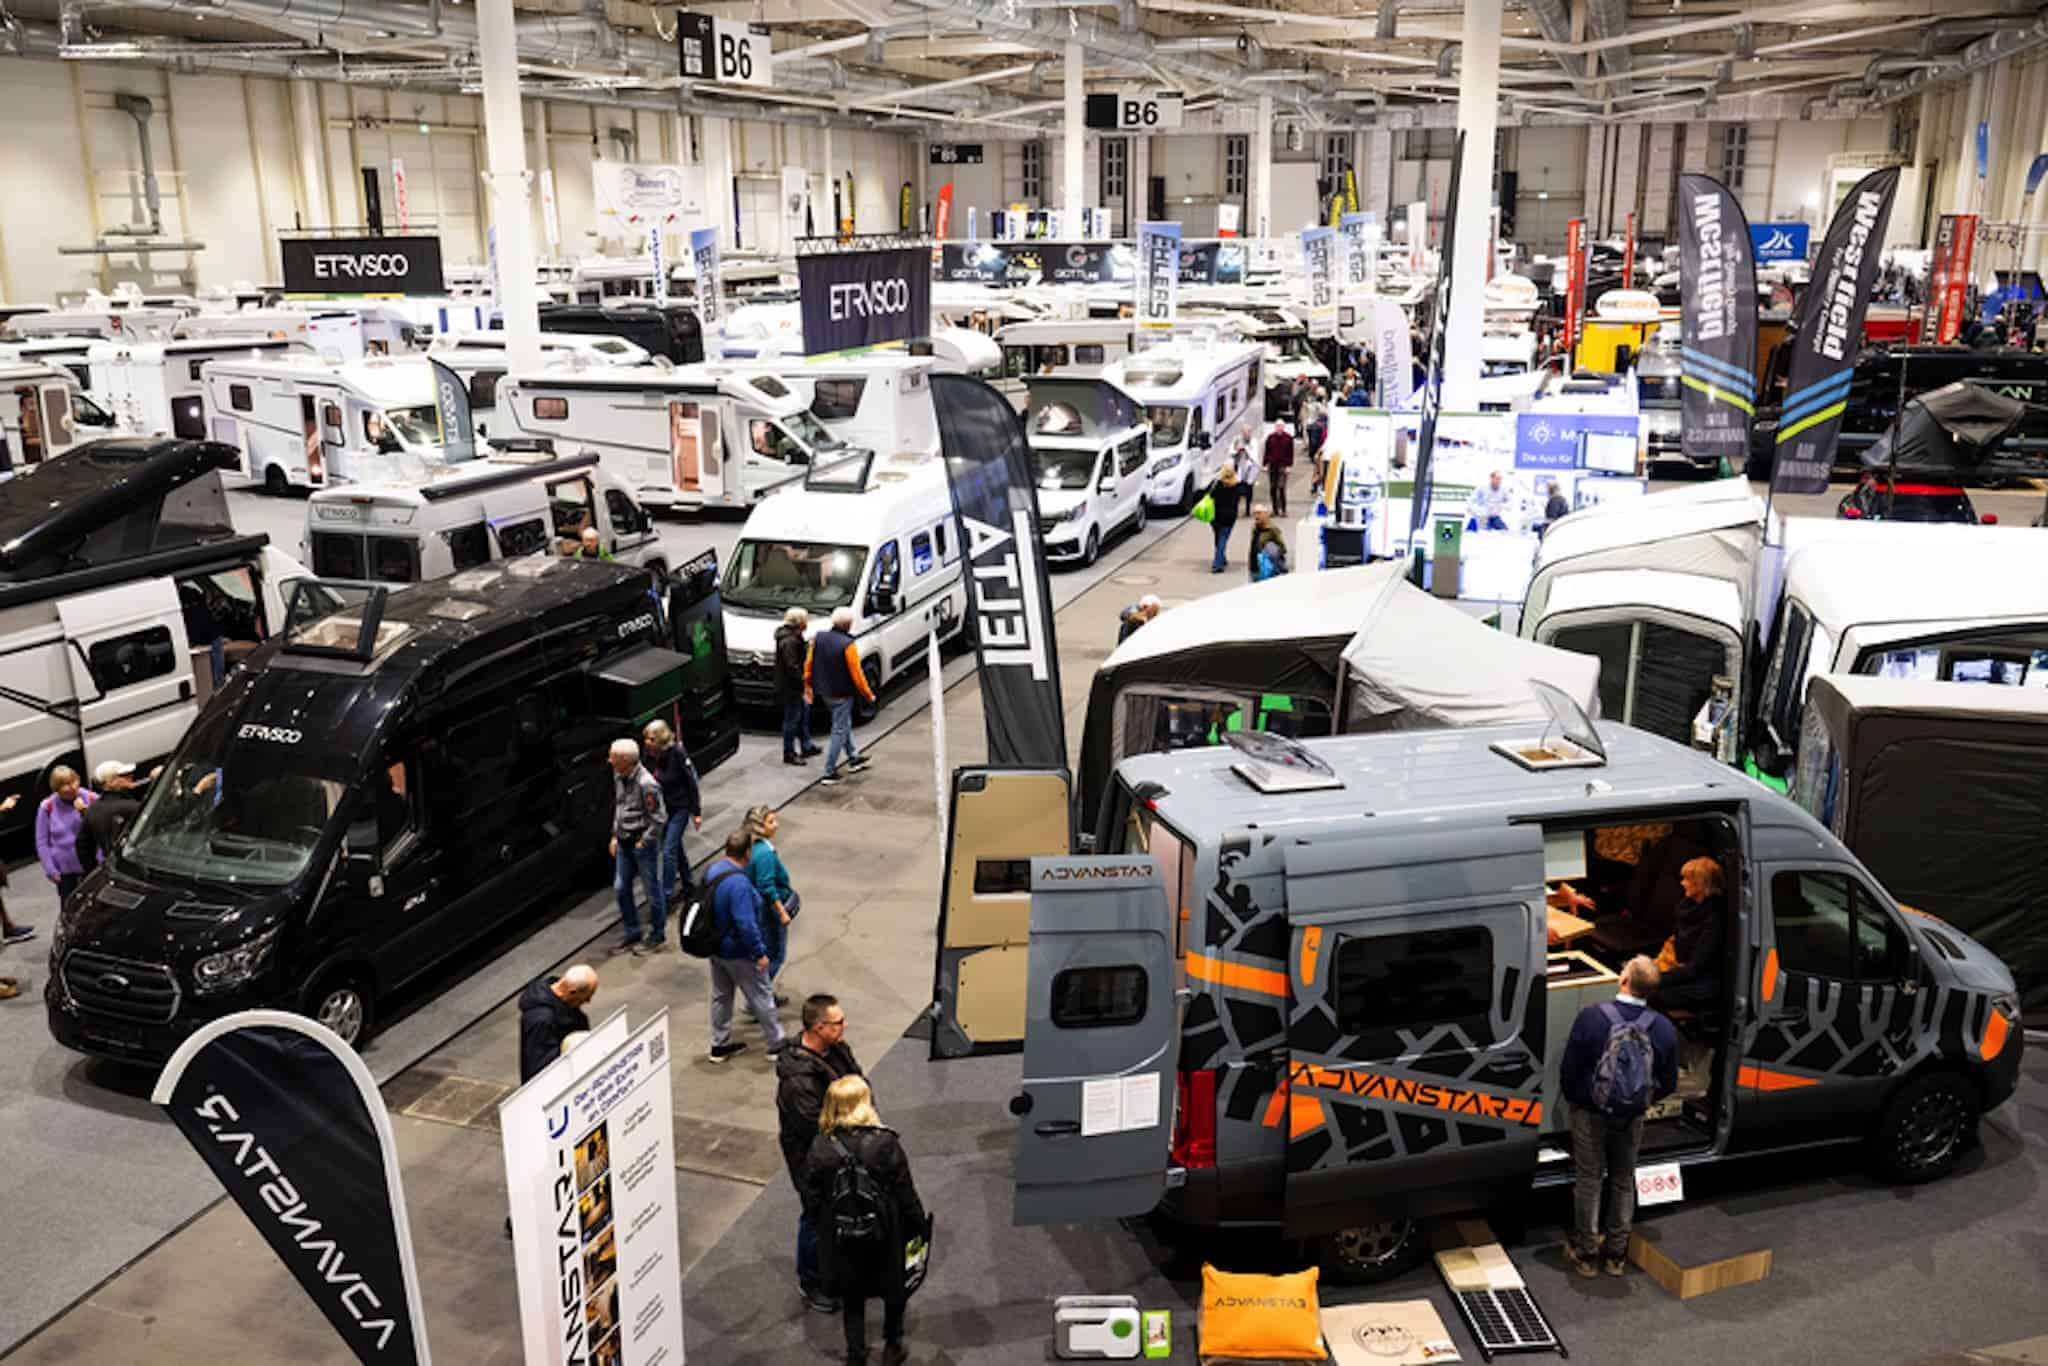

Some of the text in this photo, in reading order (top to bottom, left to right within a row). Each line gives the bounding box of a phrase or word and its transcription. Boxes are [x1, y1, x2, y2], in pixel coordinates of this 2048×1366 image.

[720, 33, 752, 79] B6
[1123, 101, 1158, 125] B6
[314, 254, 409, 278] ETRVSCO
[1149, 233, 1177, 318] EHLERS
[829, 277, 910, 322] ETRVSCO
[1041, 864, 1153, 881] ADVANSTAR
